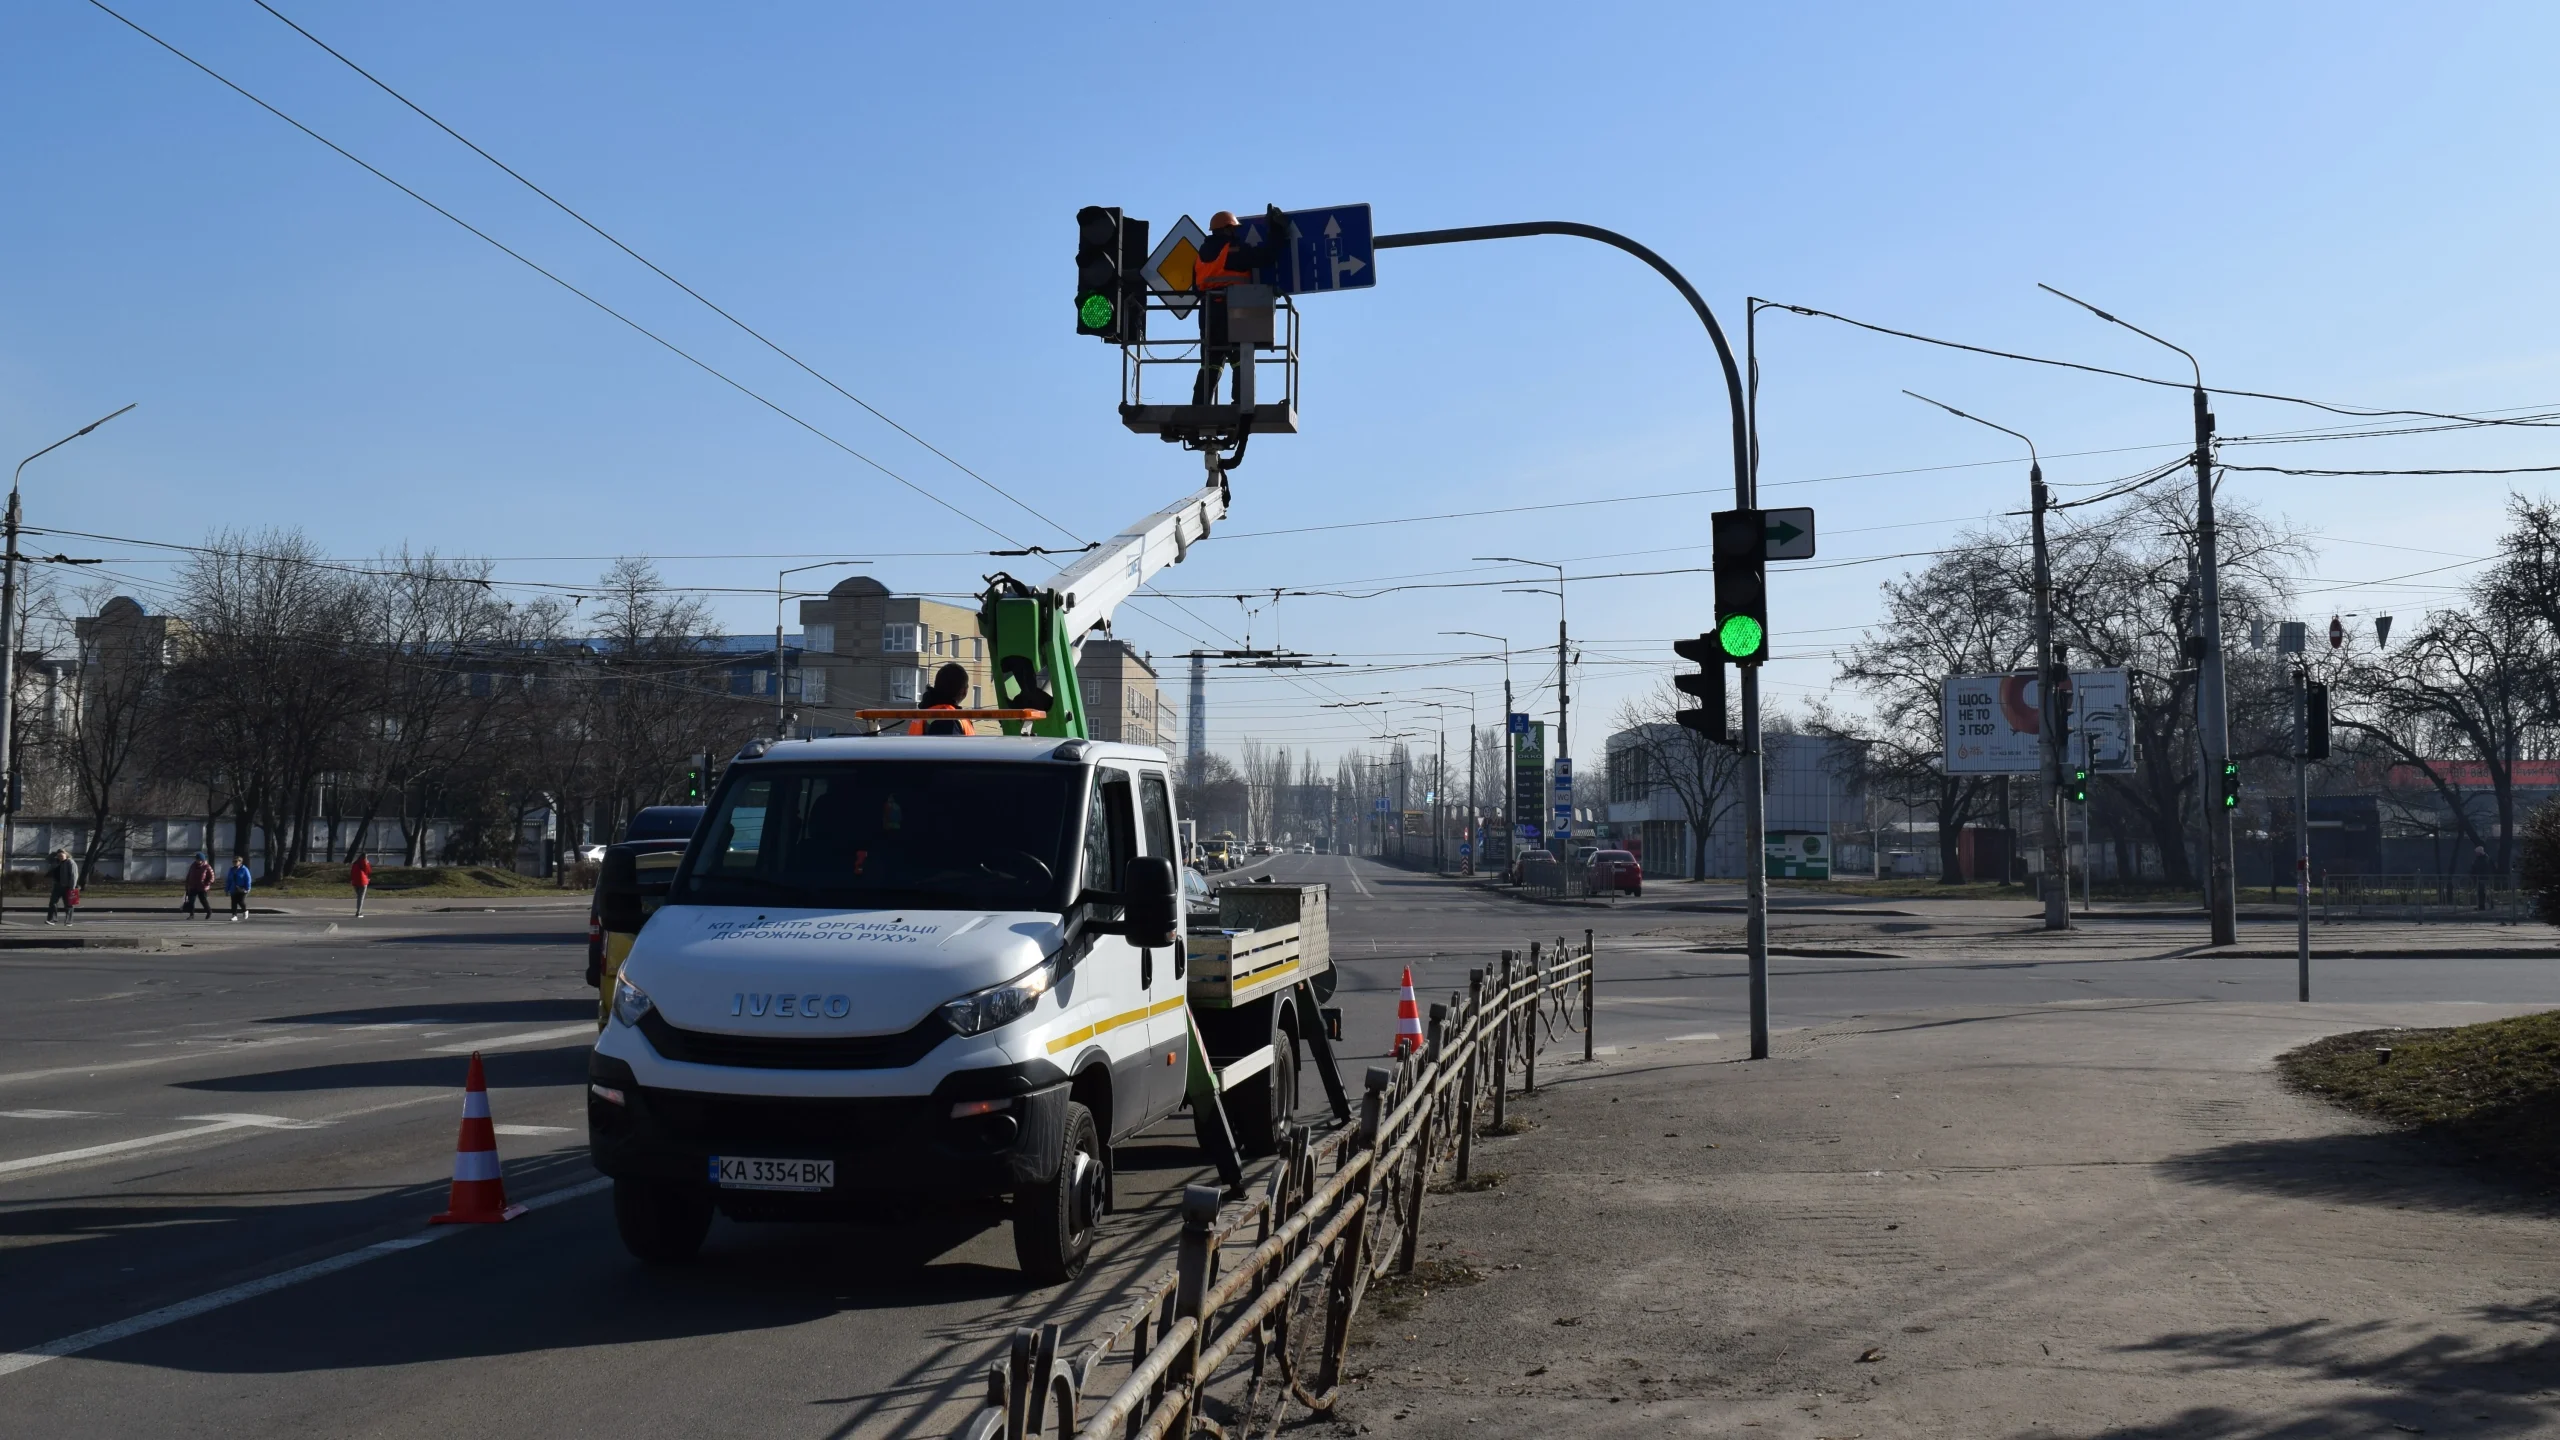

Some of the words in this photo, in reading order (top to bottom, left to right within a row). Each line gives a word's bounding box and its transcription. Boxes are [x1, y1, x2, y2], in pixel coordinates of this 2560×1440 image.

[1958, 694, 1992, 707] ЩОСЬ
[1959, 709, 1973, 720] НЕ
[1976, 709, 1990, 720] ТО
[1968, 724, 1995, 735] ГБО?
[2225, 765, 2236, 774] 34
[707, 922, 734, 930] КП
[739, 921, 812, 930] «ЦЕНТР
[817, 922, 941, 934] ОРГАНІЗАЦІЇ
[711, 931, 853, 941] ДОРОЖНЬОГО
[857, 932, 918, 943] РУХУ»
[731, 993, 851, 1018] IVECO
[720, 1160, 747, 1180] KA
[752, 1161, 798, 1182] 3354
[802, 1163, 831, 1184] BK
